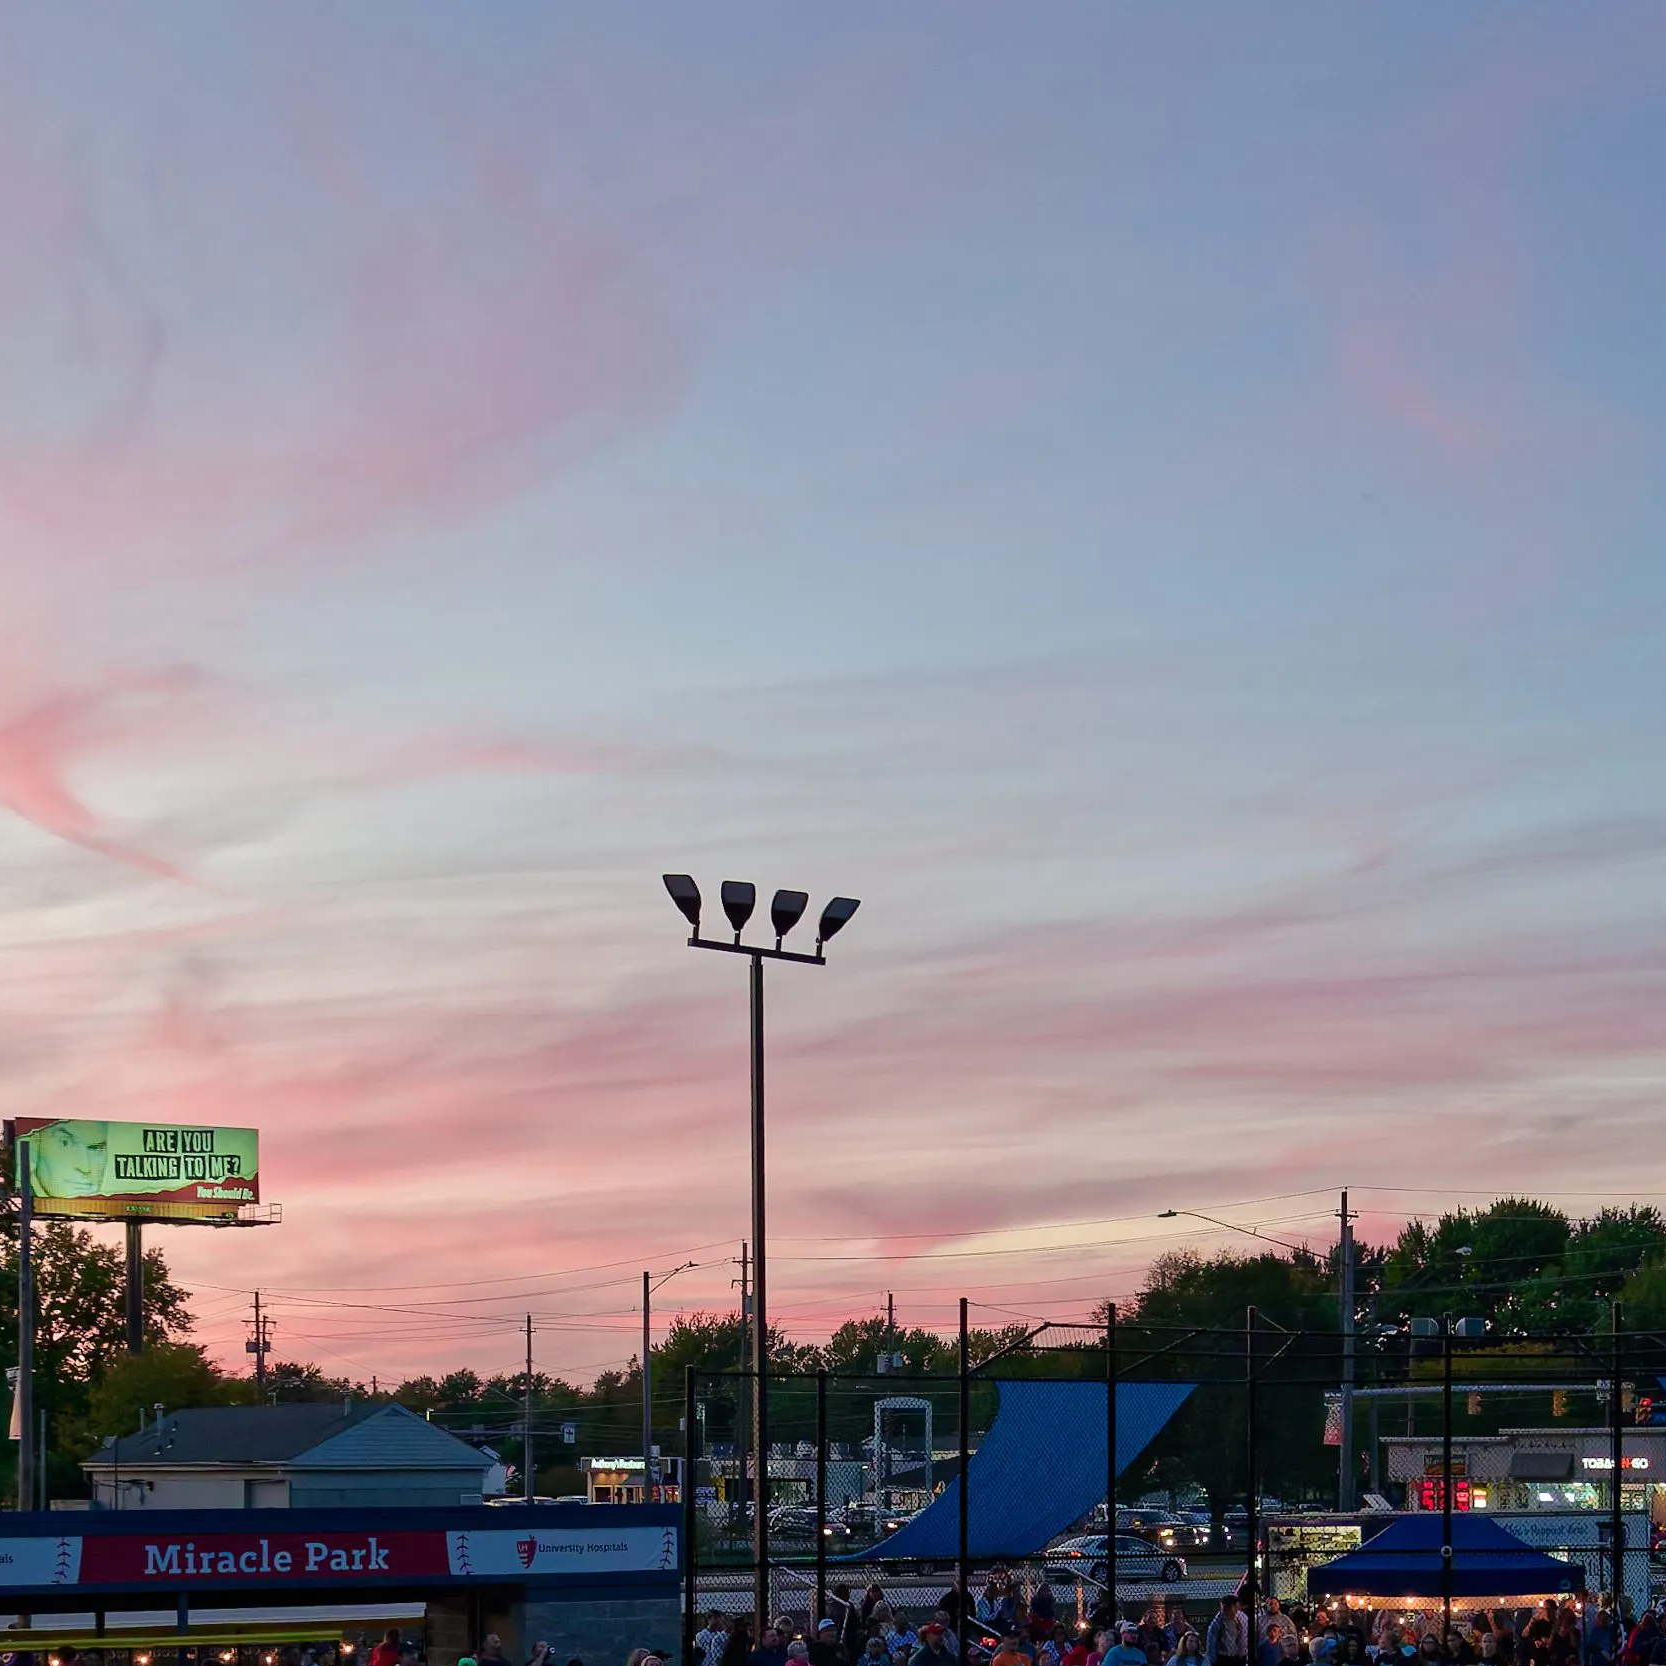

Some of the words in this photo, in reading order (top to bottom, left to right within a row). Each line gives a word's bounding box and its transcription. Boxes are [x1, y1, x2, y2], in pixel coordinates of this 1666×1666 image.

[146, 1131, 176, 1152] ARE
[183, 1132, 213, 1152] YOU
[117, 1157, 178, 1177] TALKING
[185, 1157, 204, 1177] TO
[210, 1157, 241, 1177] ME?
[196, 1186, 213, 1198] You
[213, 1186, 242, 1200] Should
[144, 1539, 293, 1575] Miracle
[304, 1537, 390, 1572] Park
[538, 1543, 583, 1554] University
[587, 1542, 628, 1553] Hospitals
